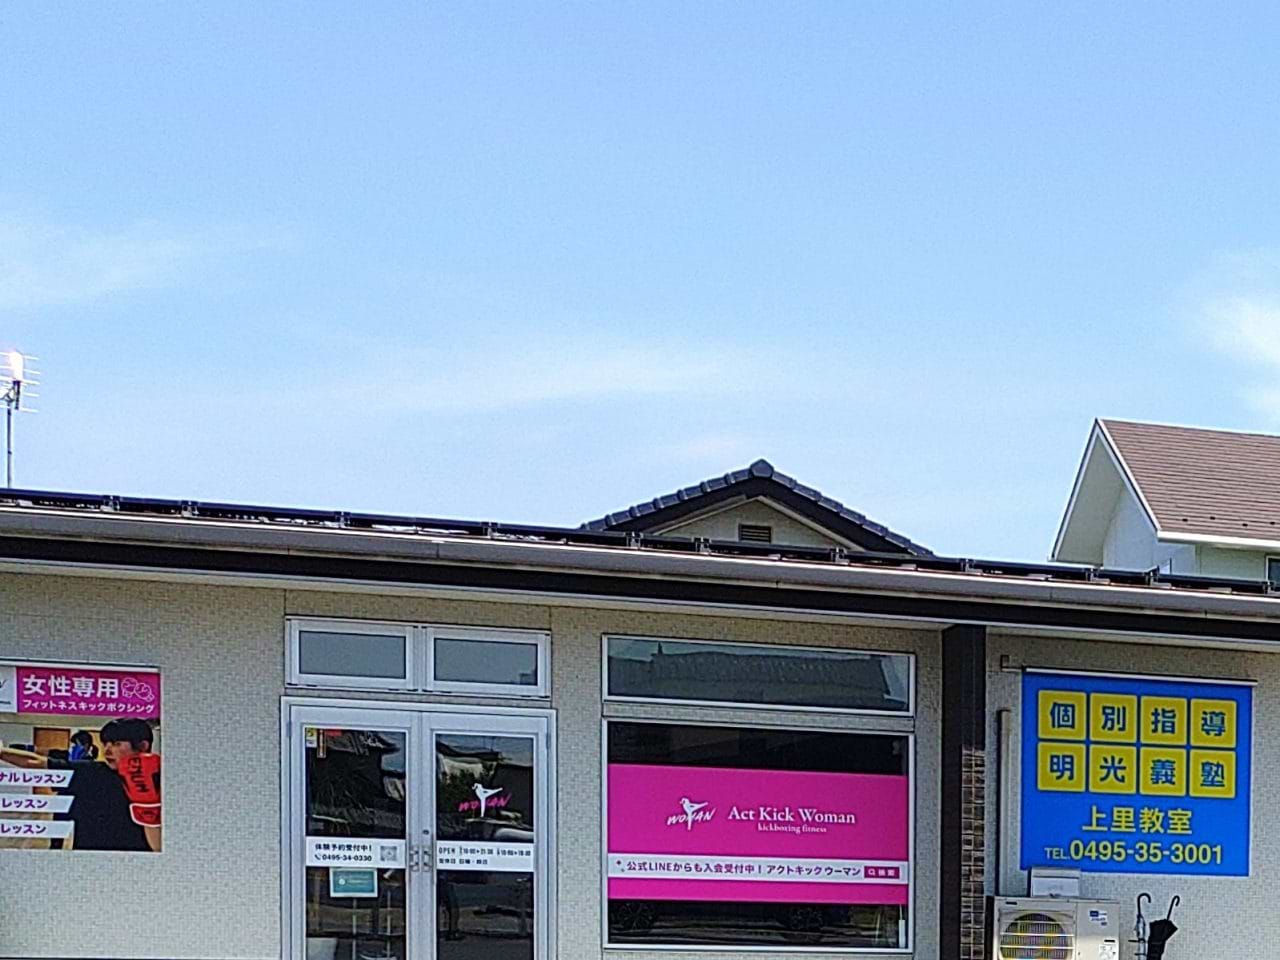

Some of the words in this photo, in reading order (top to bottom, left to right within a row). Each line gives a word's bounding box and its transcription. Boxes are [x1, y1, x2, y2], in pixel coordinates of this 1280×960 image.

[22, 674, 119, 699] 女性専用
[23, 700, 155, 714] フィットネスキックボクシング
[1049, 701, 1226, 737] 個別指導
[1049, 754, 1225, 788] 明光義塾
[728, 806, 755, 821] Act
[759, 806, 795, 823] Kick
[799, 808, 856, 825] Woman
[1082, 805, 1193, 835] 上里教室
[757, 823, 800, 835] kickboxing
